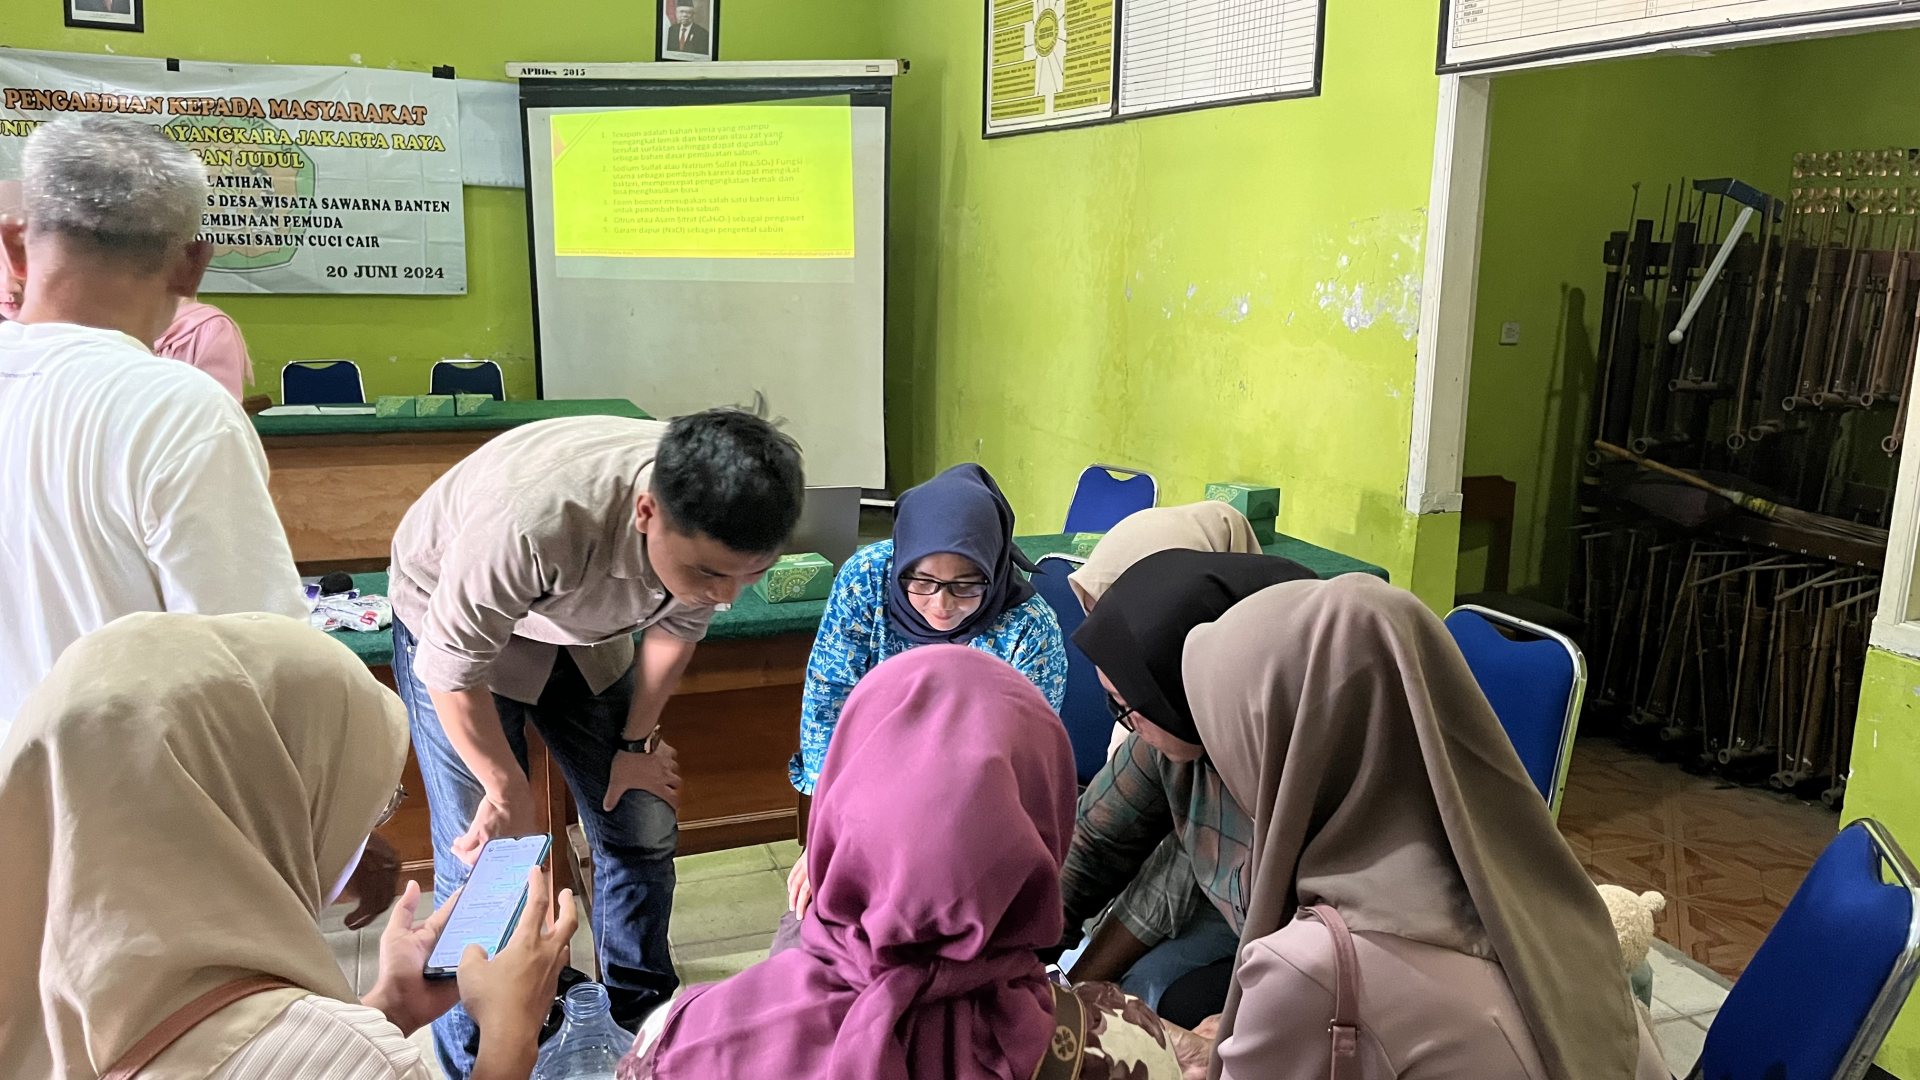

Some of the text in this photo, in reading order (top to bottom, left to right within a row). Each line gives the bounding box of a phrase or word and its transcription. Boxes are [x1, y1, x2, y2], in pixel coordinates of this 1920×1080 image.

[562, 68, 586, 76] 2015
[3, 88, 163, 115] PENGABDIAN
[168, 97, 266, 118] KEPADA
[269, 99, 428, 125] MASYARAKAT
[154, 125, 293, 145] AYANGKARA
[295, 130, 388, 149] JAKARTA
[391, 134, 446, 151] RAYA
[236, 151, 304, 168] JUDUL
[207, 175, 272, 189] LATIHAN
[219, 195, 258, 207] DESA
[262, 196, 318, 209] WISATA
[321, 198, 391, 211] SAWARNA
[395, 200, 450, 213] BANTEN
[201, 213, 343, 229] EMBINAAN PEMUDA
[194, 232, 380, 248] ODUKSI SABUN CUCI CAIR
[326, 265, 444, 279] 20 JUNI 2024
